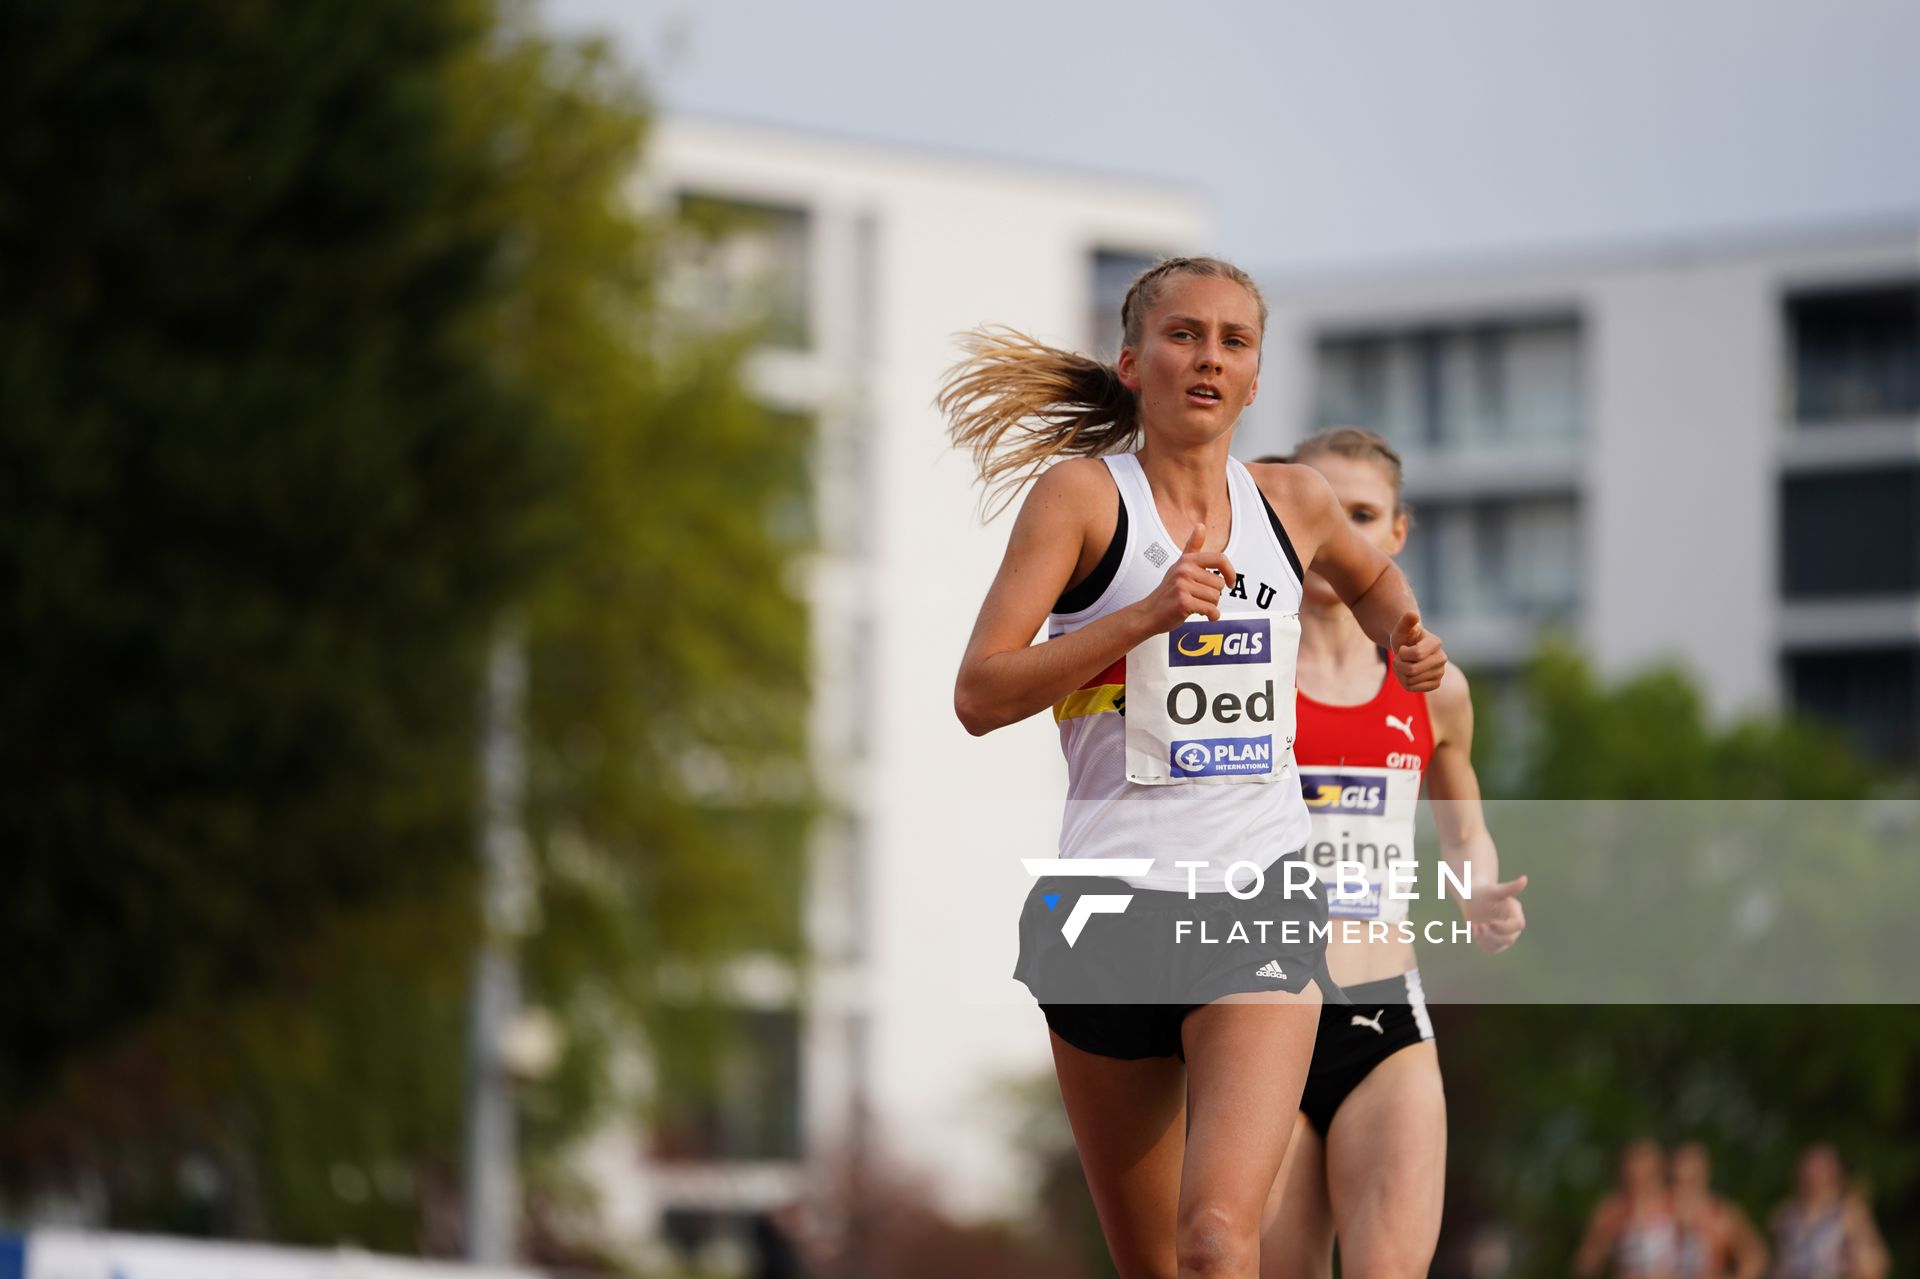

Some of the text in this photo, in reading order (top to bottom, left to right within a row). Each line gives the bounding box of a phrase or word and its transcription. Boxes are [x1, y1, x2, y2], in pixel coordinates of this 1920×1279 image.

[1223, 632, 1263, 656] GLS
[1166, 679, 1275, 725] Oed
[1214, 743, 1269, 762] PLAN
[1215, 763, 1269, 771] INTERNATIONAL
[1341, 786, 1380, 809] GLS
[1303, 831, 1402, 869] eine
[1255, 970, 1288, 980] adidas
